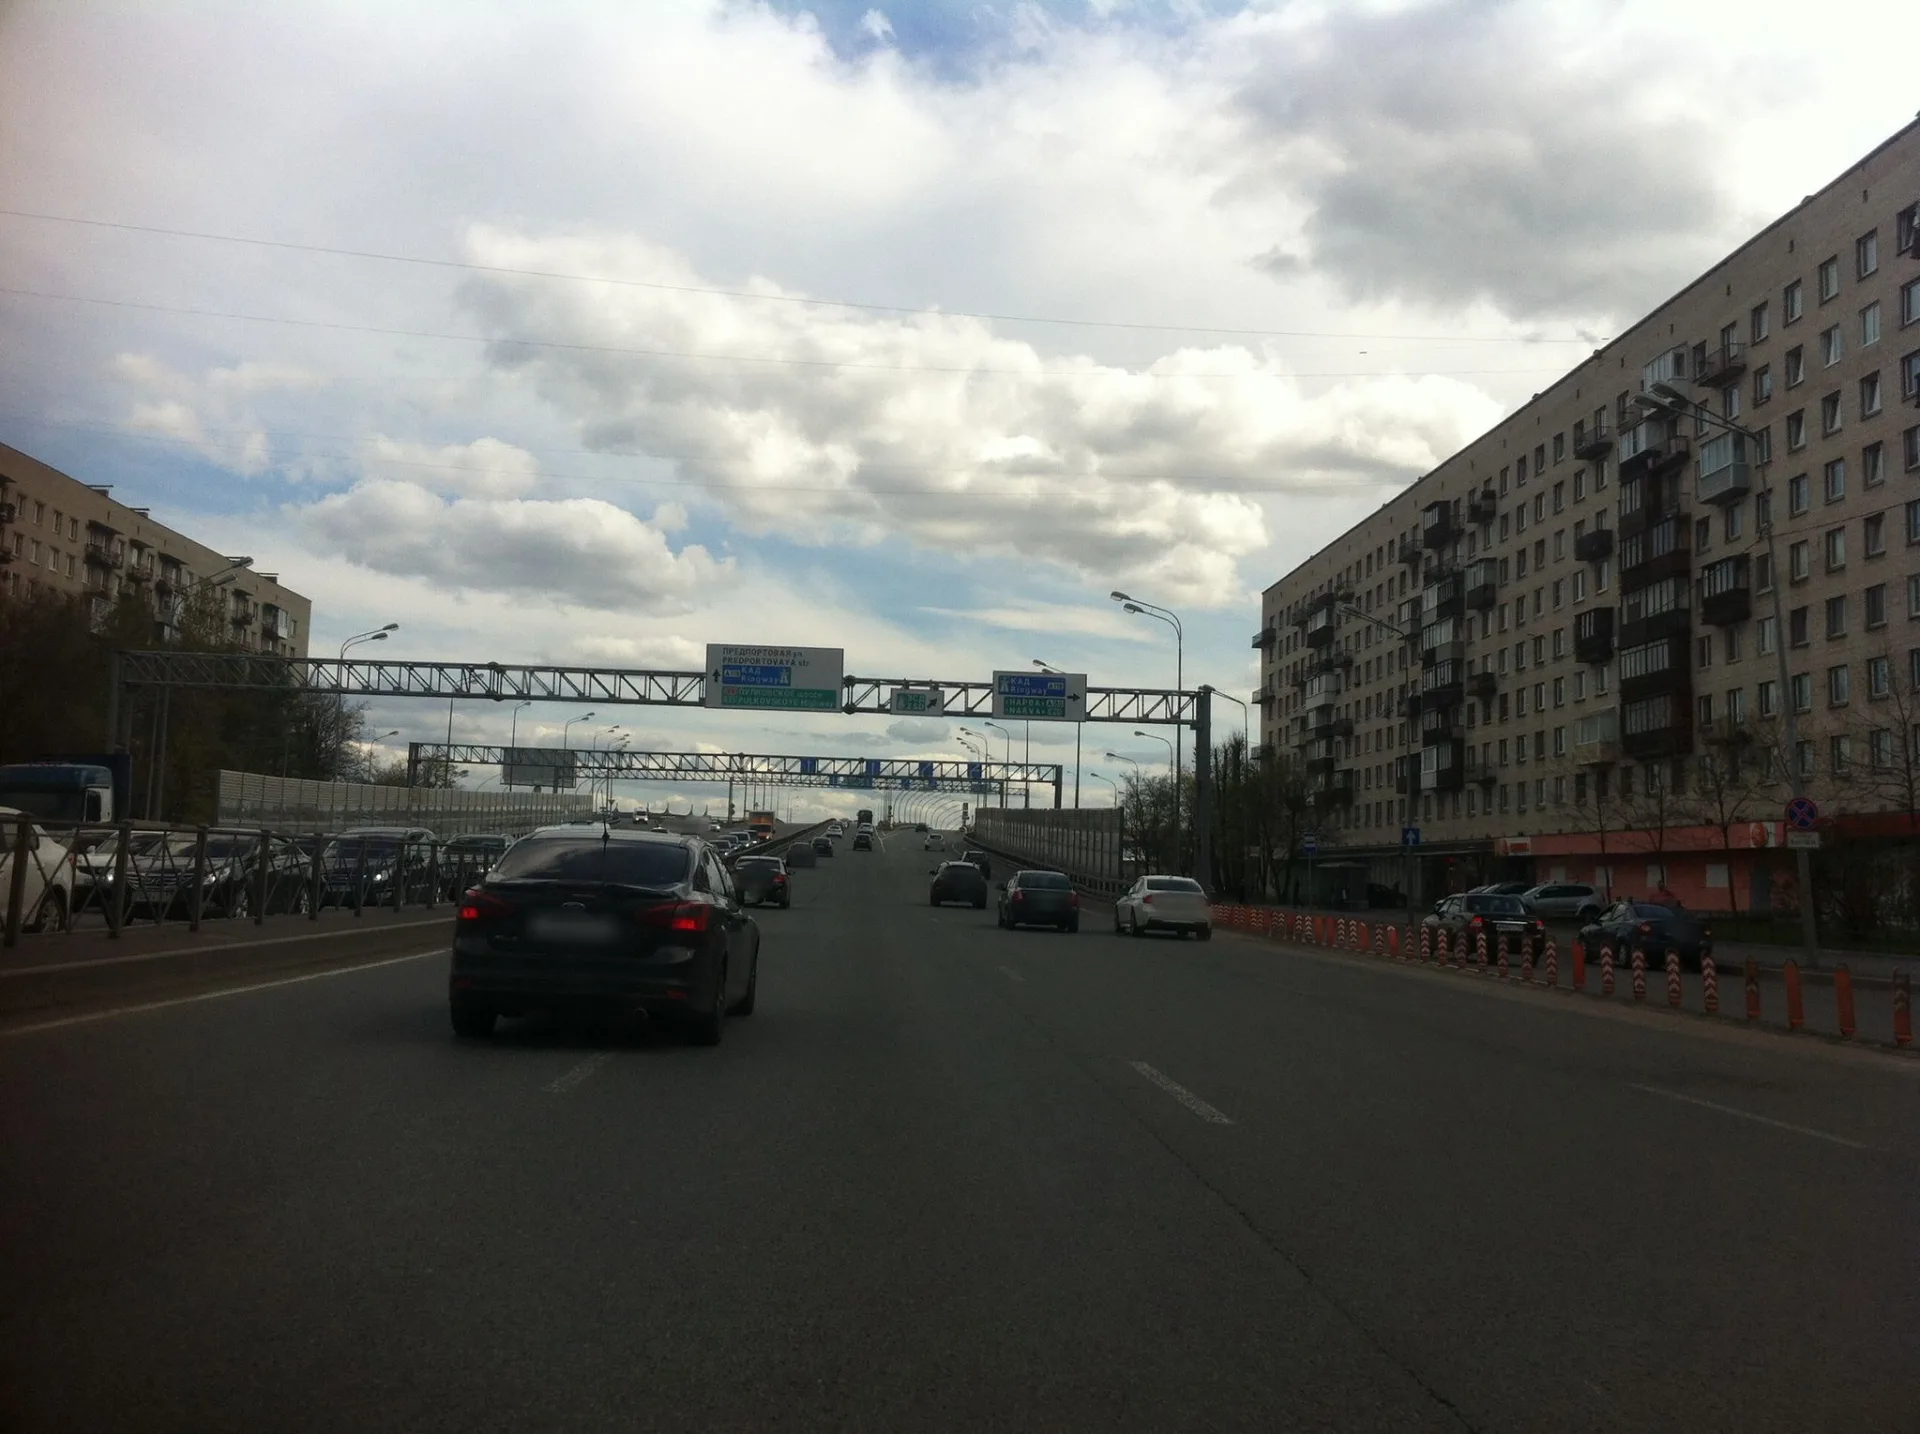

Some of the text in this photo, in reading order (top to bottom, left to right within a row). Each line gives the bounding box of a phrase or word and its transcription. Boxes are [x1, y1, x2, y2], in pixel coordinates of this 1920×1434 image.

[722, 647, 792, 657] ПРЕДПОРТОВАЯ
[722, 656, 795, 666] PREDPORTOVAYA
[741, 667, 761, 675] КАД
[741, 675, 778, 684] Ringway
[1011, 677, 1030, 686] КАД
[1011, 686, 1048, 695] Ringway
[907, 702, 925, 710] ZSD
